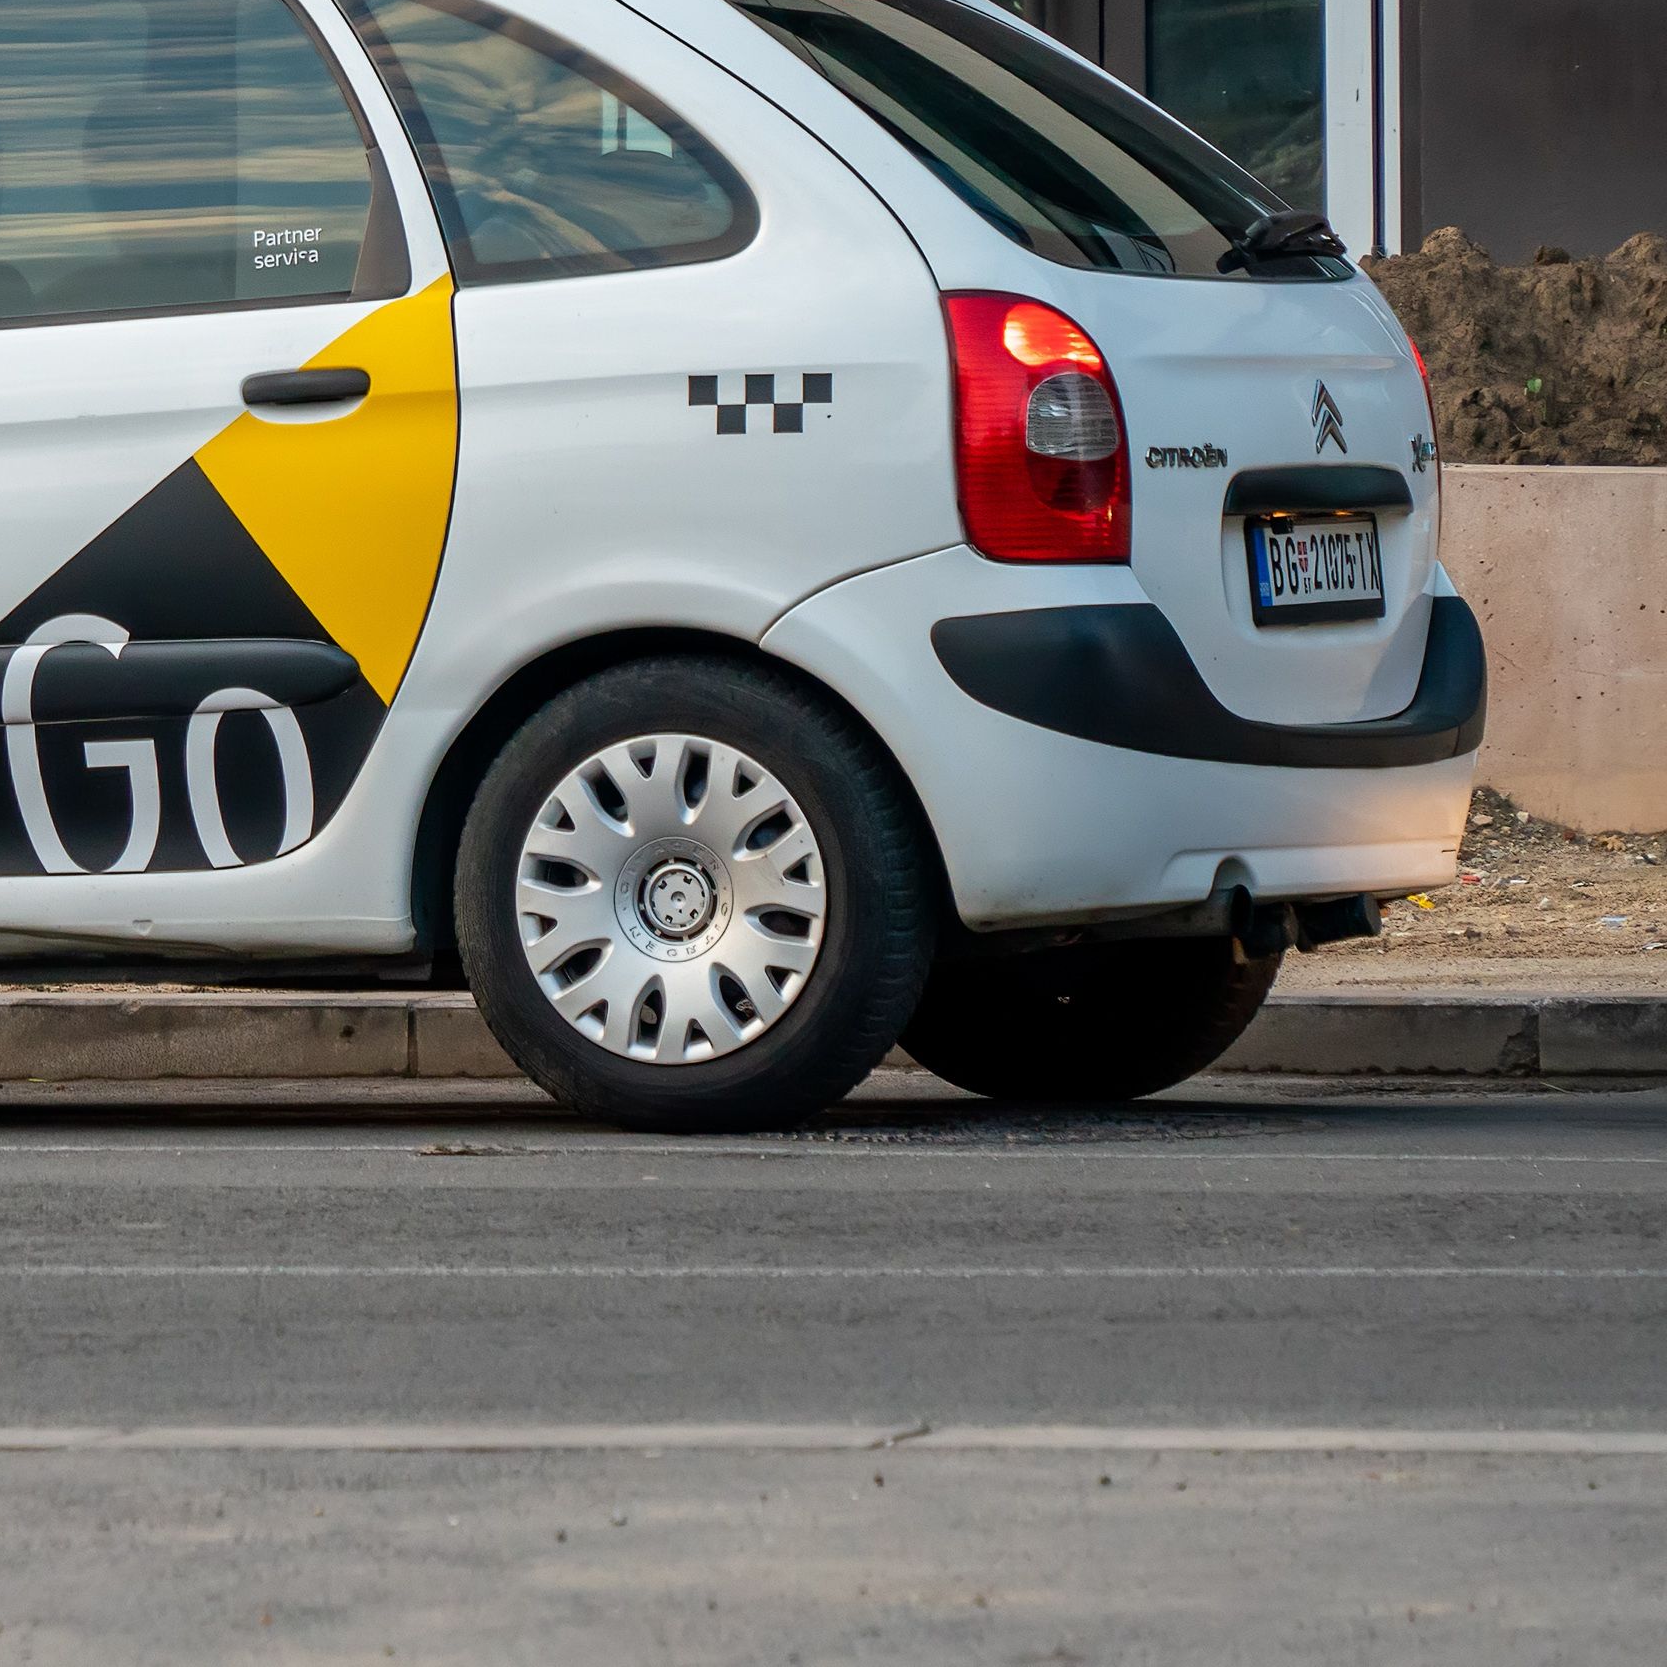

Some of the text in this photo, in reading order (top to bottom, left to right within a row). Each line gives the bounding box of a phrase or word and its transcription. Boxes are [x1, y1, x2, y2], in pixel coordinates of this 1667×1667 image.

[253, 227, 322, 248] Partner
[1144, 442, 1229, 470] CITROËN
[1268, 536, 1300, 597] BG
[0, 612, 315, 874] Go
